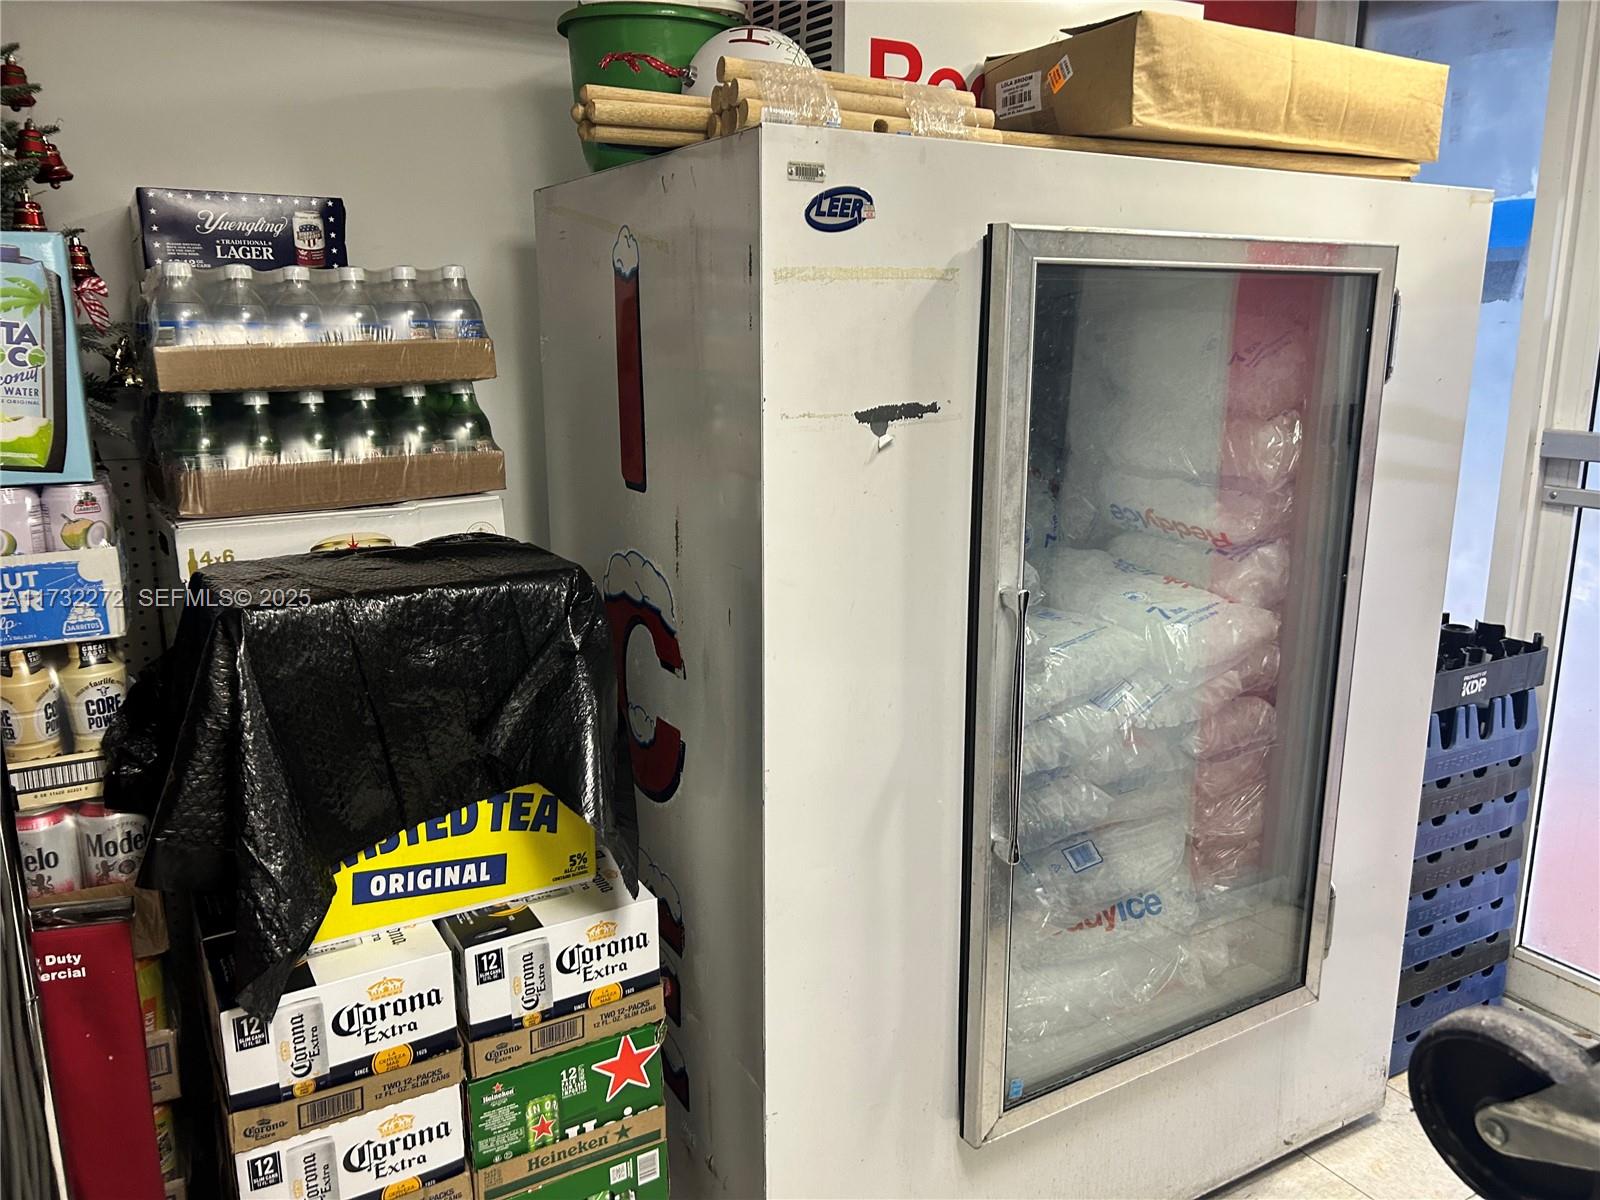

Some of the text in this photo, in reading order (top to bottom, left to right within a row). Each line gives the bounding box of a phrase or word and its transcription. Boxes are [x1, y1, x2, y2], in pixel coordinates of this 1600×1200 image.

[815, 192, 864, 224] LEER
[195, 209, 288, 238] Yuengling
[215, 245, 275, 261] LAGER
[220, 239, 268, 247] TRADITIONAL
[0, 321, 39, 347] TA
[5, 387, 40, 397] WATER
[0, 570, 39, 591] UT
[64, 621, 101, 633] JARRITOS
[89, 677, 116, 688] fairlife
[1461, 677, 1488, 697] KDP
[487, 791, 559, 834] TEA
[24, 848, 60, 873] elo
[569, 851, 588, 867] 5%
[370, 861, 492, 897] ORIGINAL
[45, 953, 82, 967] Duty
[481, 952, 498, 972] 12
[555, 931, 650, 976] Corona
[38, 967, 87, 984] ercial
[521, 951, 540, 1012] Corona
[536, 963, 546, 997] Extra
[583, 962, 628, 984] Extra
[331, 988, 443, 1038] Corona
[600, 999, 651, 1021] TWO 12-PACKS
[623, 1011, 639, 1019] SLIM
[640, 1003, 657, 1014] CANS
[240, 1016, 261, 1037] 12
[251, 1032, 265, 1041] CANS
[363, 1020, 418, 1045] Extra
[290, 1013, 313, 1079] Corona
[309, 1025, 321, 1063] Extra
[485, 1046, 521, 1063] Corona
[494, 1055, 512, 1065] Extra
[354, 1066, 369, 1077] SINCE
[383, 1068, 443, 1092] TWO 12-PACKS
[560, 1066, 578, 1082] 12
[374, 1093, 383, 1101] 12
[397, 1086, 410, 1094] OZ.
[411, 1080, 429, 1089] SLIM
[430, 1072, 450, 1083] CANS
[482, 1087, 515, 1104] Heineken
[243, 1120, 286, 1141] Corona
[255, 1132, 276, 1142] Extra
[343, 1121, 451, 1173] Corona
[527, 1132, 609, 1173] Heineken
[254, 1156, 275, 1177] 12
[303, 1152, 321, 1200] orona
[374, 1153, 427, 1180] Extra
[320, 1163, 332, 1198] Extra
[429, 1187, 455, 1200] PACKS
